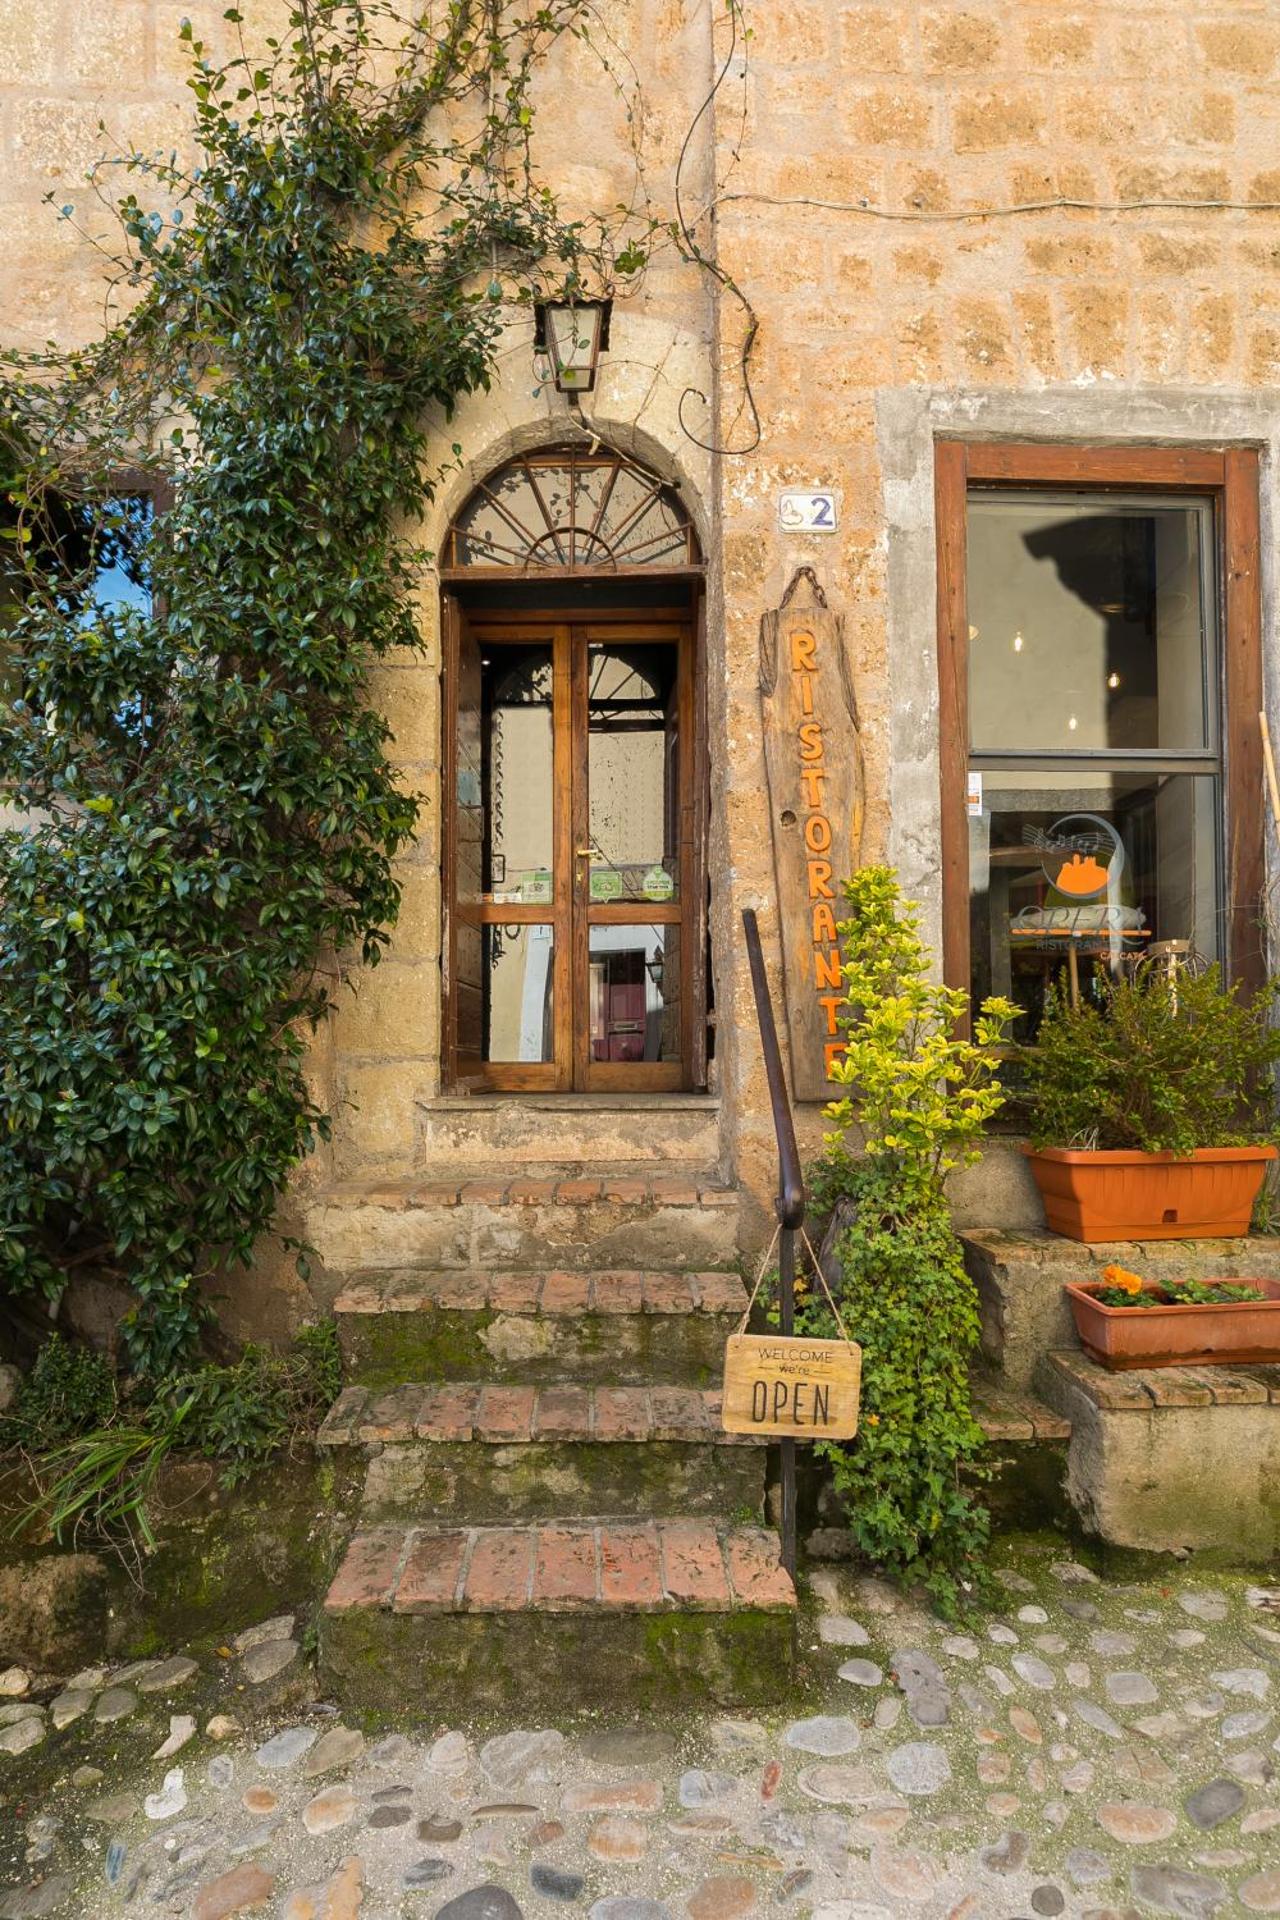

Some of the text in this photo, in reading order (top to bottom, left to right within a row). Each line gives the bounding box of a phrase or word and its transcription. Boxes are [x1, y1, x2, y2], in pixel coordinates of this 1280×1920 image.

[758, 1348, 833, 1364] WELCOME
[778, 1365, 811, 1376] we're
[752, 1380, 830, 1426] OPEN
